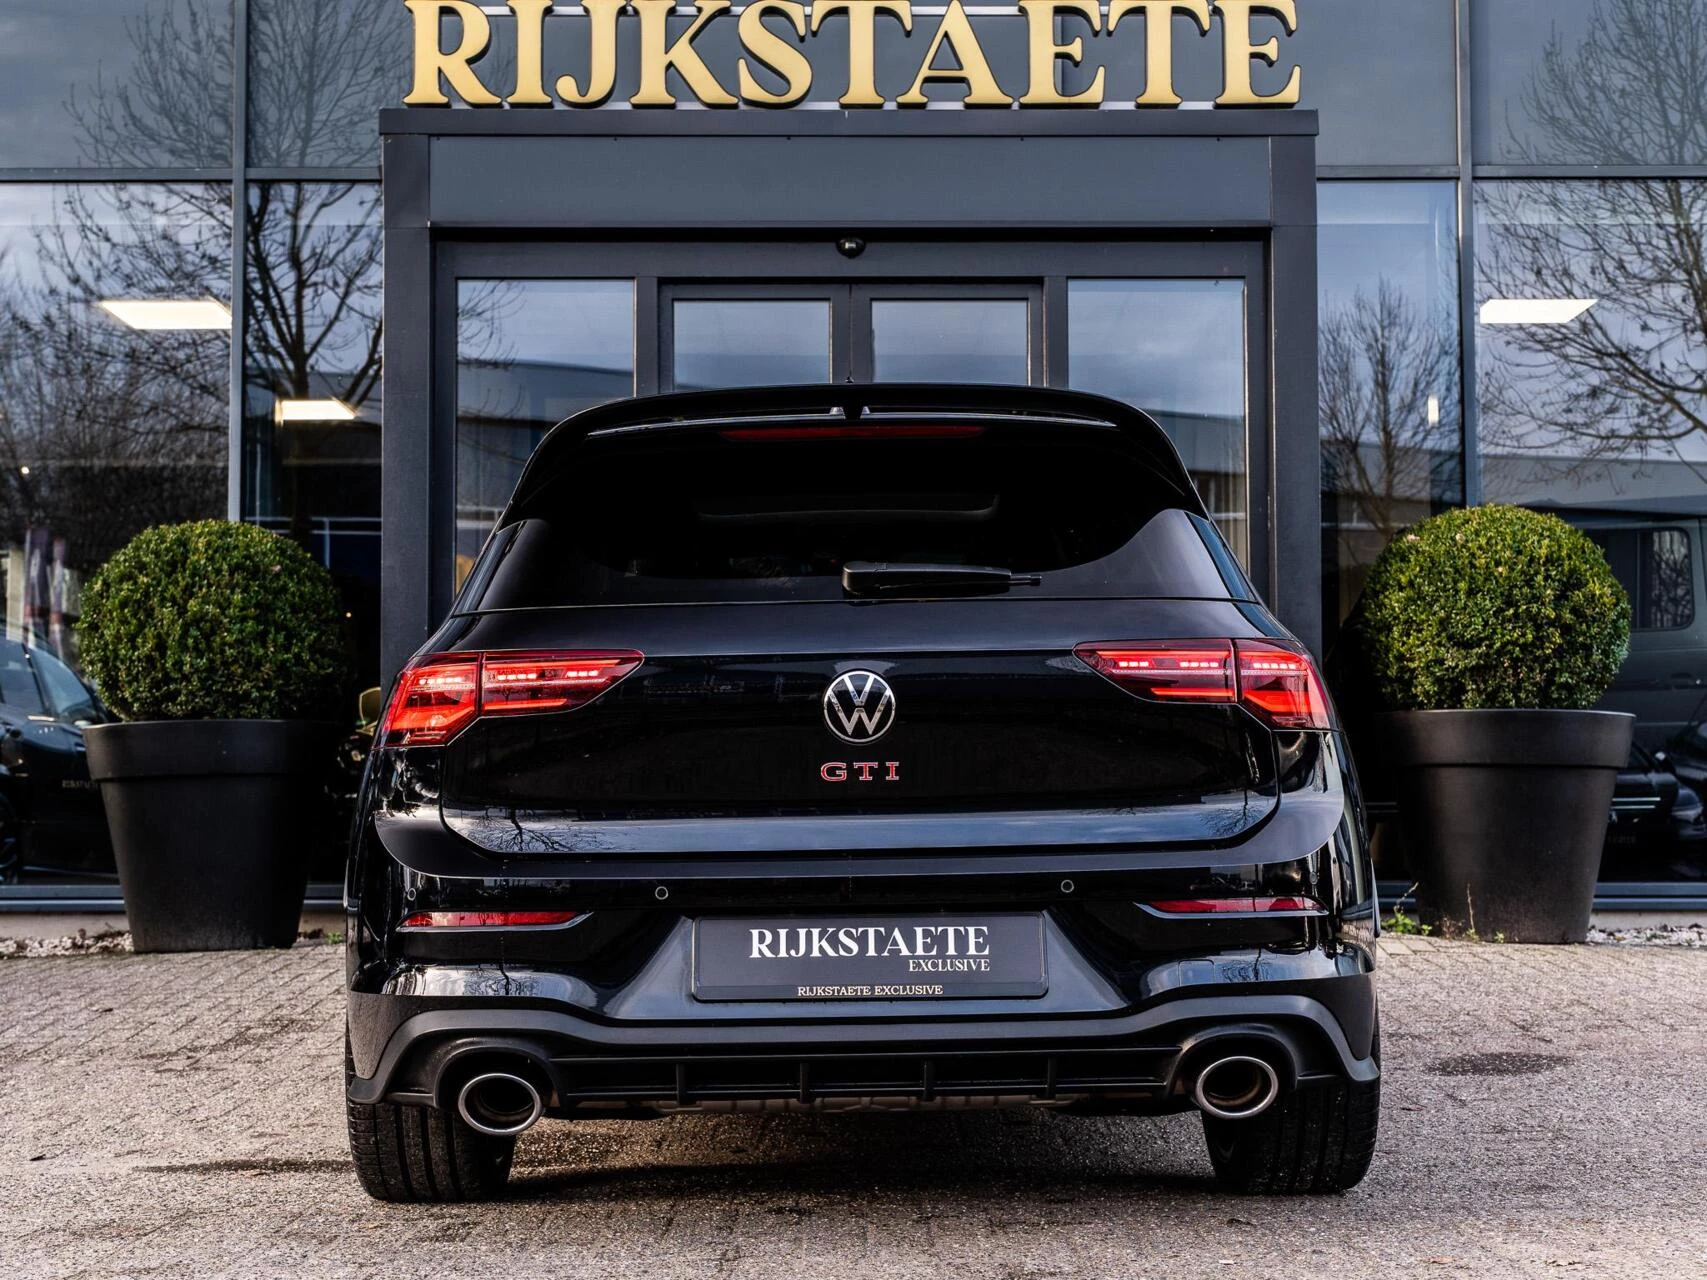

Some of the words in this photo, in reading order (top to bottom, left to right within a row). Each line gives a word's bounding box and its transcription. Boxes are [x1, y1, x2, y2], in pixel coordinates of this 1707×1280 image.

[403, 0, 1303, 108] RIJKSTAETE
[821, 762, 899, 781] GTI
[749, 926, 990, 958] RIJKSTAETE
[908, 958, 990, 972] EXCLUSIVE
[797, 986, 871, 996] RIJKSTAETE
[874, 985, 943, 996] EXCLUSIVE
